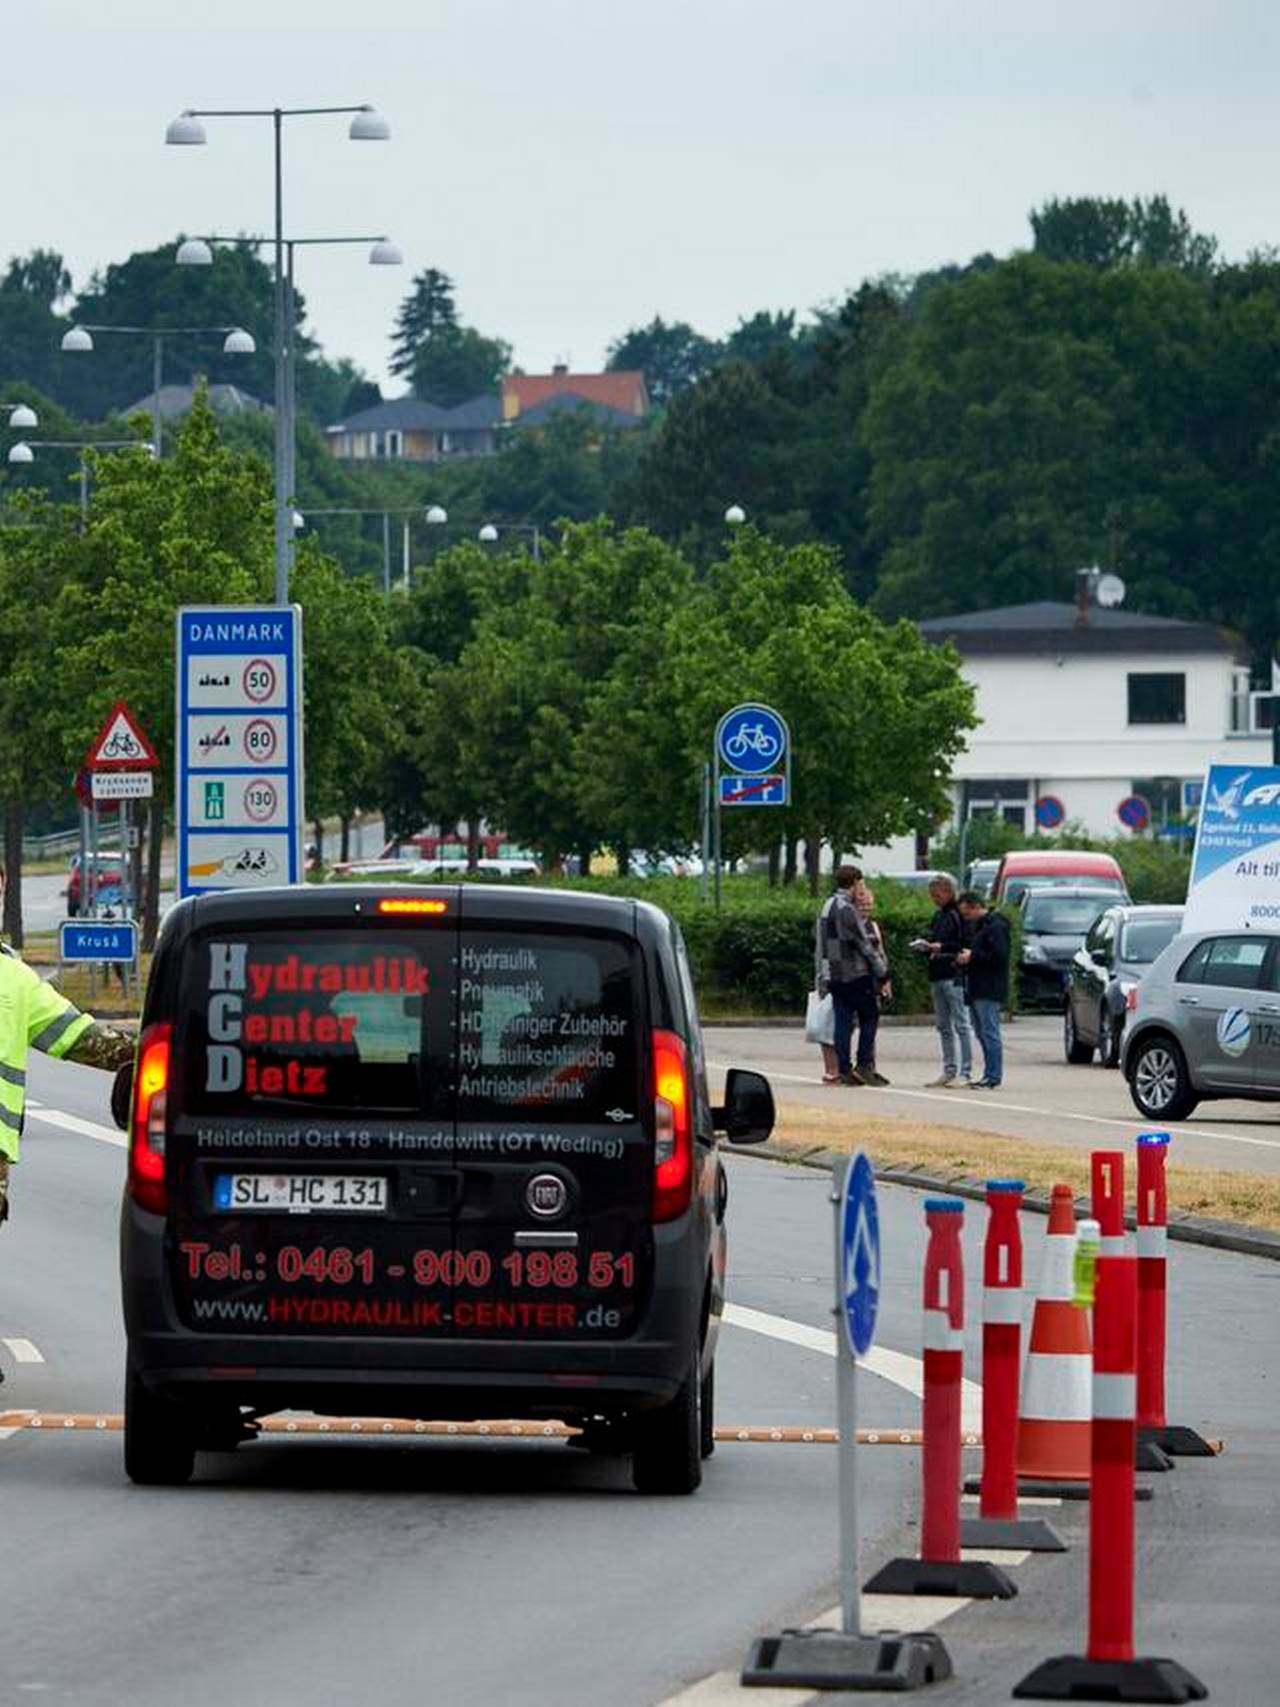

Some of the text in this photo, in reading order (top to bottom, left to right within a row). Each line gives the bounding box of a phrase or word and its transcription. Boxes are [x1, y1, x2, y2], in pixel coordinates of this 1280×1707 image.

[190, 624, 284, 641] DANMARK
[249, 671, 269, 688] 50
[250, 731, 270, 748] 80
[250, 791, 271, 806] 130
[1236, 861, 1258, 876] Alt
[77, 934, 119, 948] Kruså
[208, 943, 431, 999] Hydraulik
[461, 948, 538, 974] Hydraulik
[460, 979, 545, 1002] Pneumatik
[207, 993, 359, 1042] Center
[559, 1013, 628, 1037] Zubehör
[458, 1043, 616, 1069] Hyaulikschläuche
[205, 1045, 327, 1094] Dietz
[458, 1075, 585, 1099] Antriebstechnik
[197, 1129, 624, 1159] Heideland Ost 18 Handewitt (OT Weding)
[234, 1177, 383, 1205] SL HC 131
[180, 1242, 267, 1280] Tel.:
[278, 1246, 374, 1284] 0461
[414, 1250, 491, 1286] 900
[503, 1252, 578, 1287] 198
[588, 1252, 635, 1287] 51
[194, 1298, 621, 1328] www.HYDRAULIK-CENTER.de
